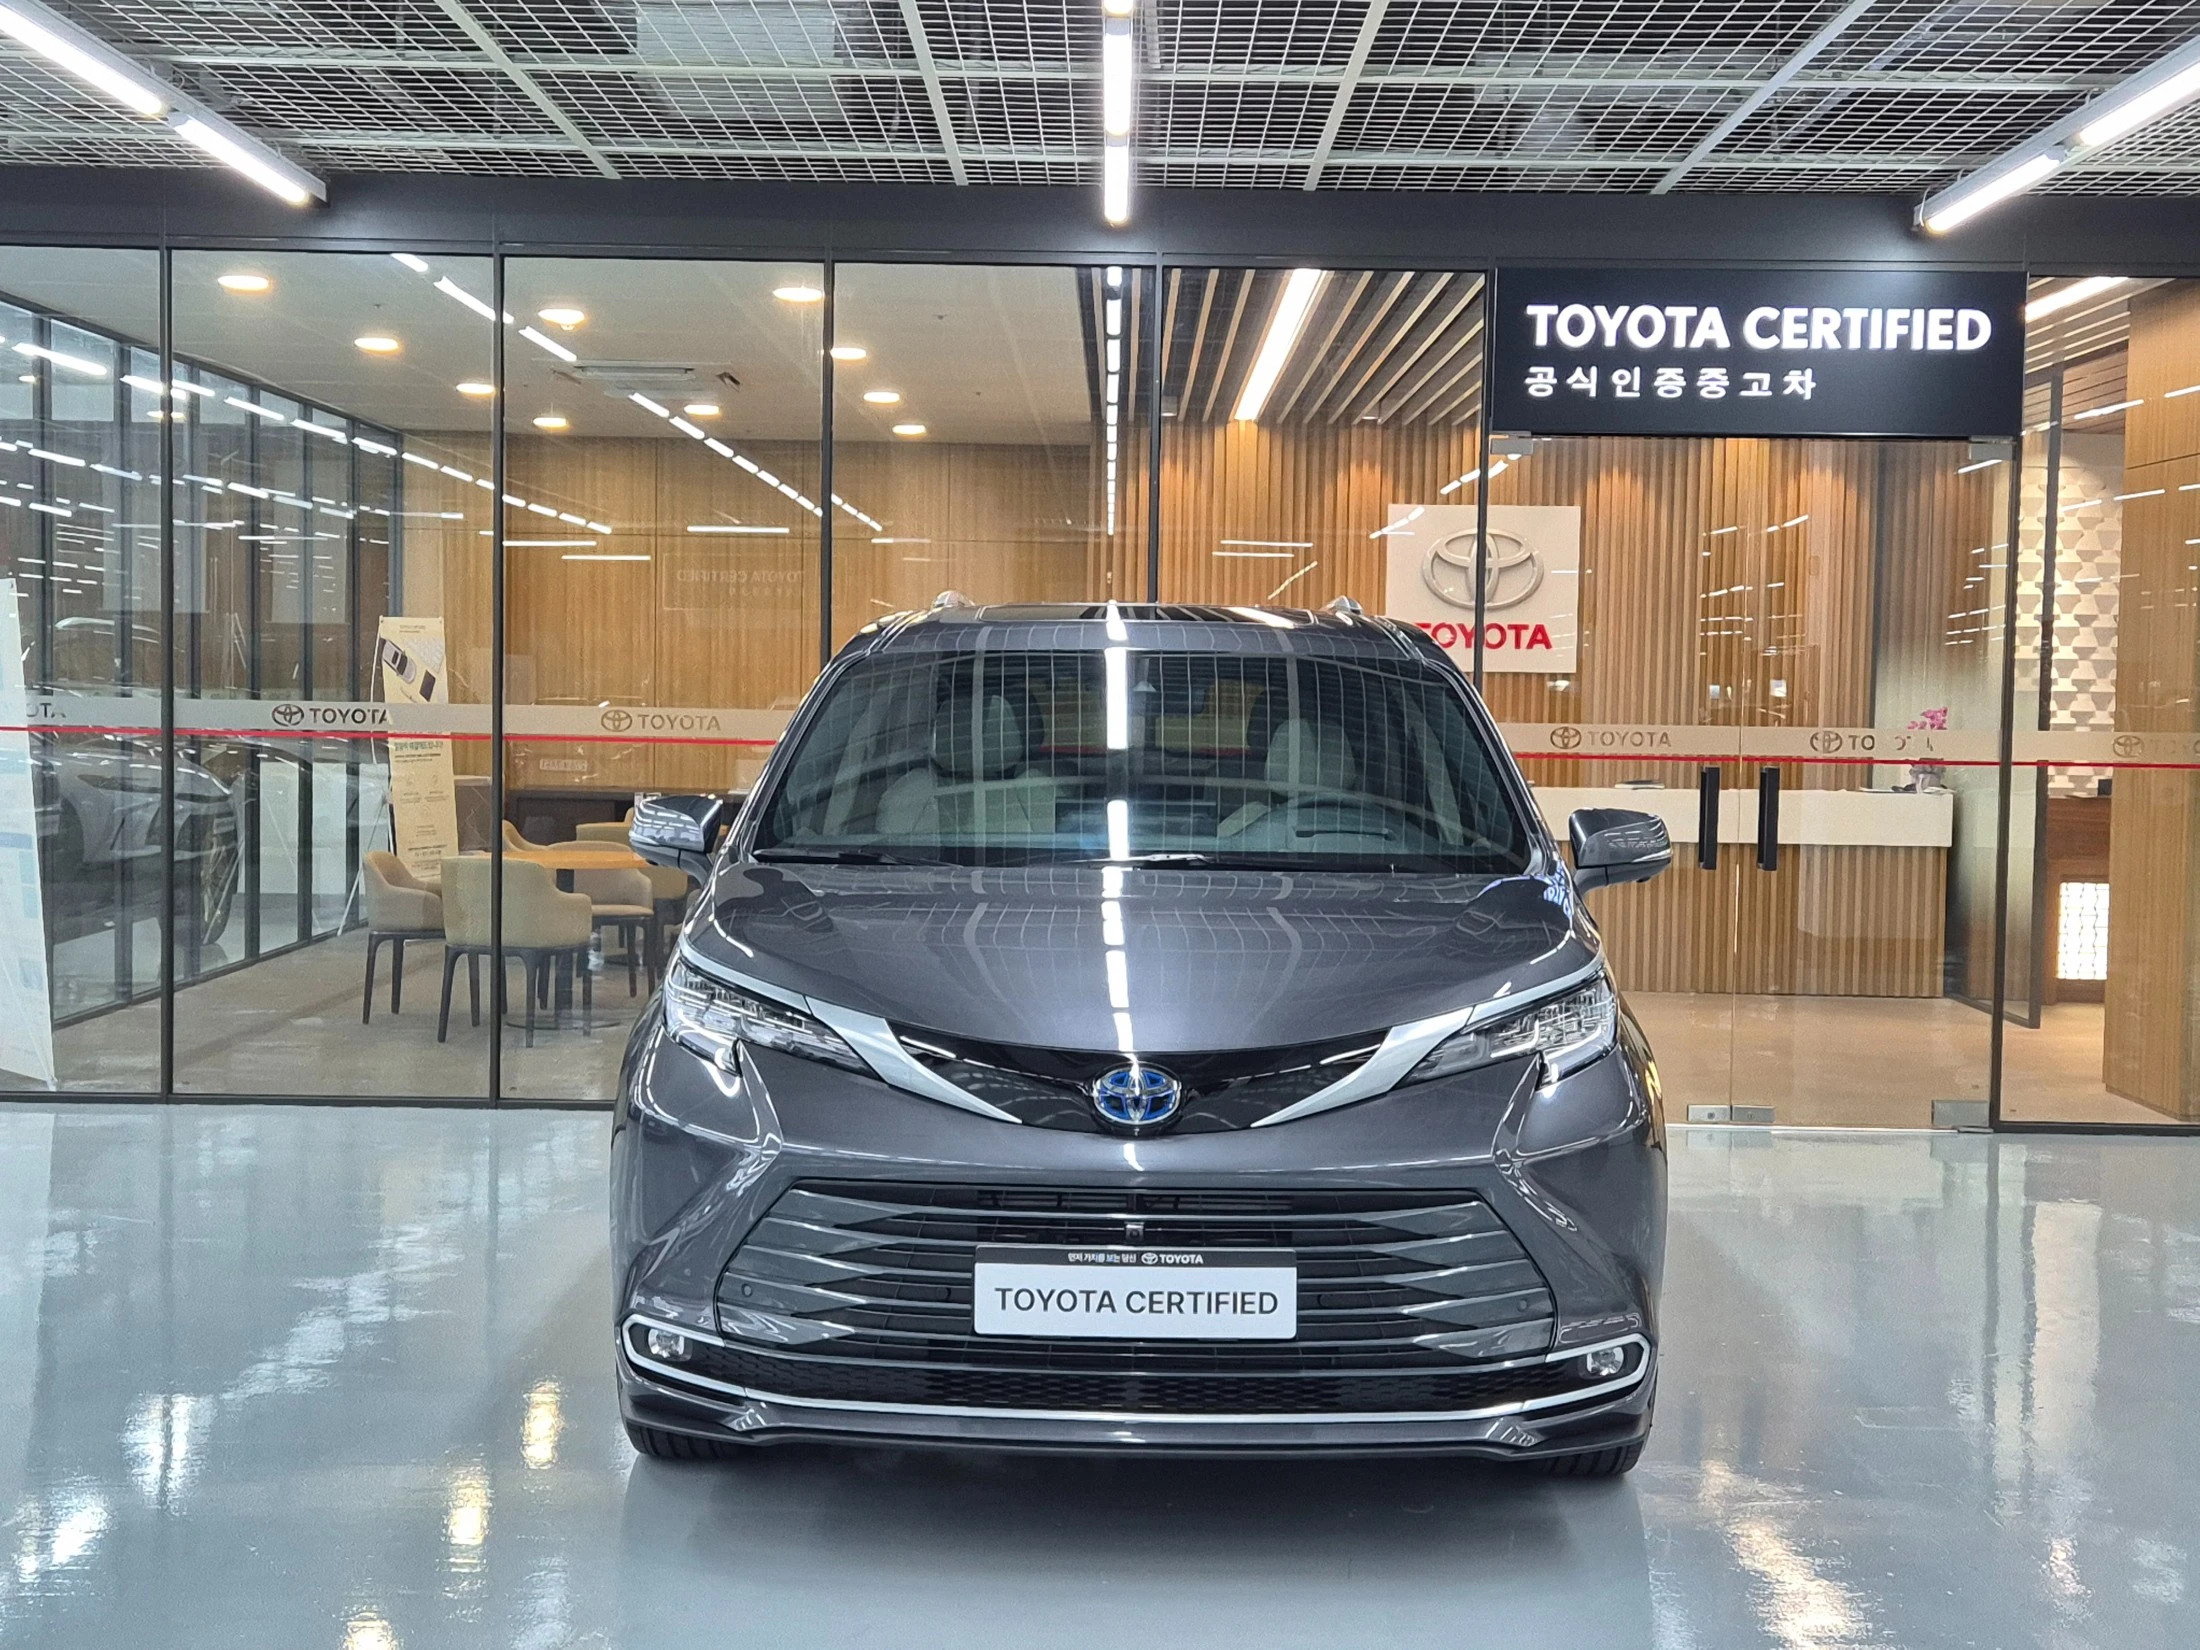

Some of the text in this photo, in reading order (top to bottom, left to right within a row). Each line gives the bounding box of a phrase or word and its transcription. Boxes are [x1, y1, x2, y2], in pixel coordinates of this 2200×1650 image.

[1525, 303, 1993, 350] TOYOTA CERTIFIED
[1524, 366, 1817, 400] 공식인증중고차
[637, 714, 721, 731] TOYOTA
[1588, 731, 1672, 747] TOYOTA
[1159, 1254, 1204, 1264] TOYOTA
[994, 1287, 1279, 1316] TOYOTA CERTIFIED
